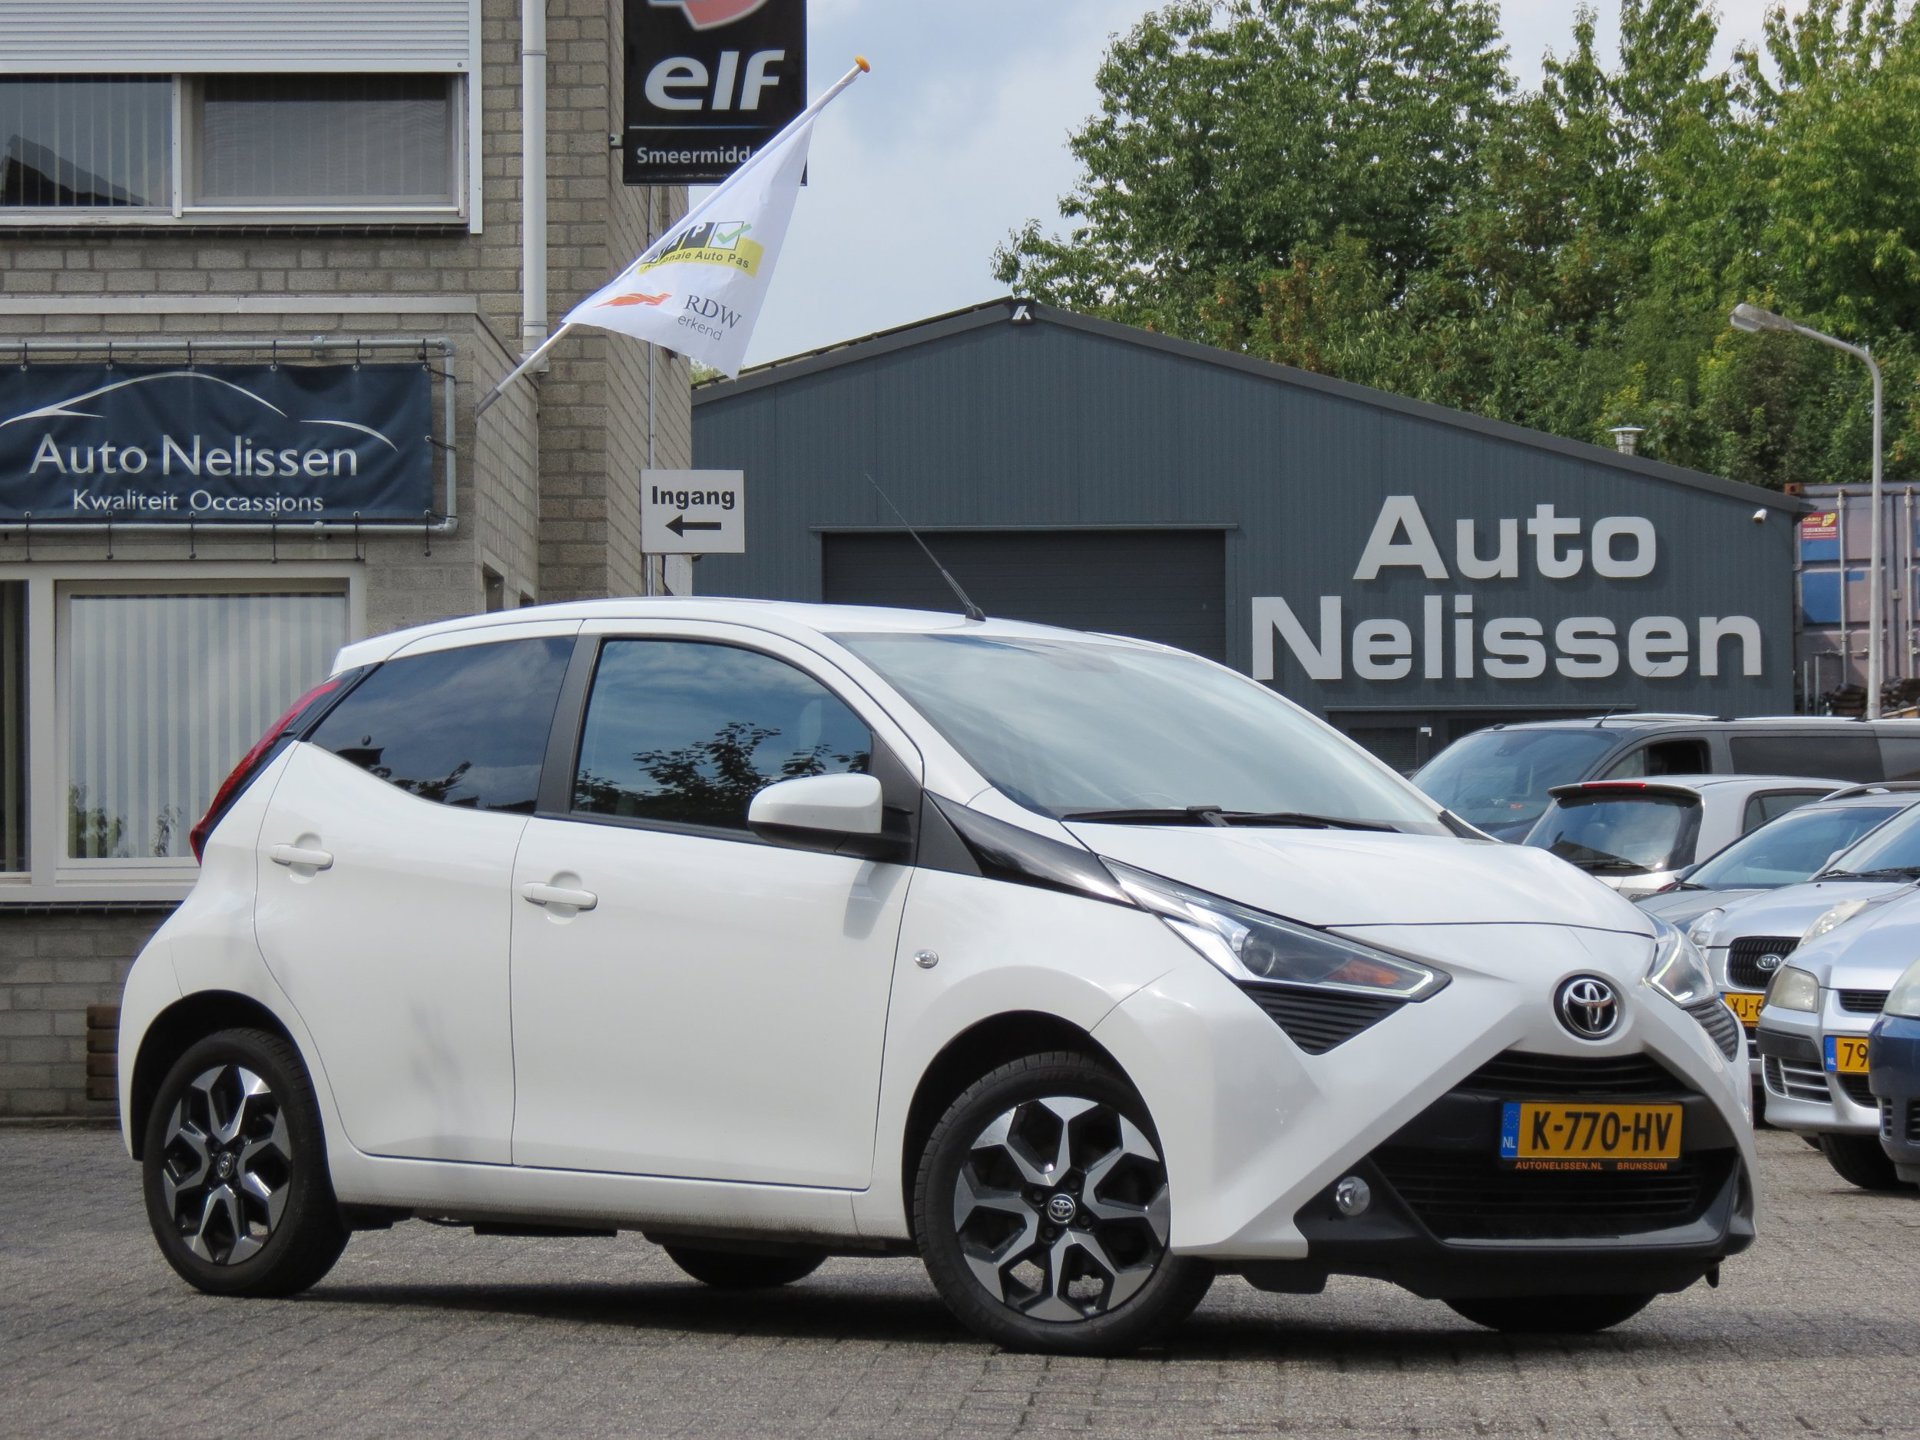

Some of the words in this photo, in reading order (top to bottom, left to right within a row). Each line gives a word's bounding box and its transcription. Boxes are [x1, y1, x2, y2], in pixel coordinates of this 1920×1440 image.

[644, 49, 785, 111] elf
[694, 250, 723, 262] Auto
[728, 253, 750, 269] Pas
[683, 294, 742, 329] RDW
[677, 314, 723, 341] erkend
[29, 433, 148, 475] Auto
[162, 433, 357, 477] Nelissen
[73, 488, 178, 512] Kwaliteit
[190, 489, 324, 513] Occassions
[651, 485, 735, 511] Ingang
[1352, 495, 1657, 580] Auto
[1250, 594, 1762, 681] Nelissen
[1502, 1136, 1516, 1149] NL
[1531, 1111, 1674, 1152] K-770-HV
[1515, 1161, 1603, 1171] AUTONELISSEN.NL
[1617, 1162, 1668, 1171] BRUNSSUM
